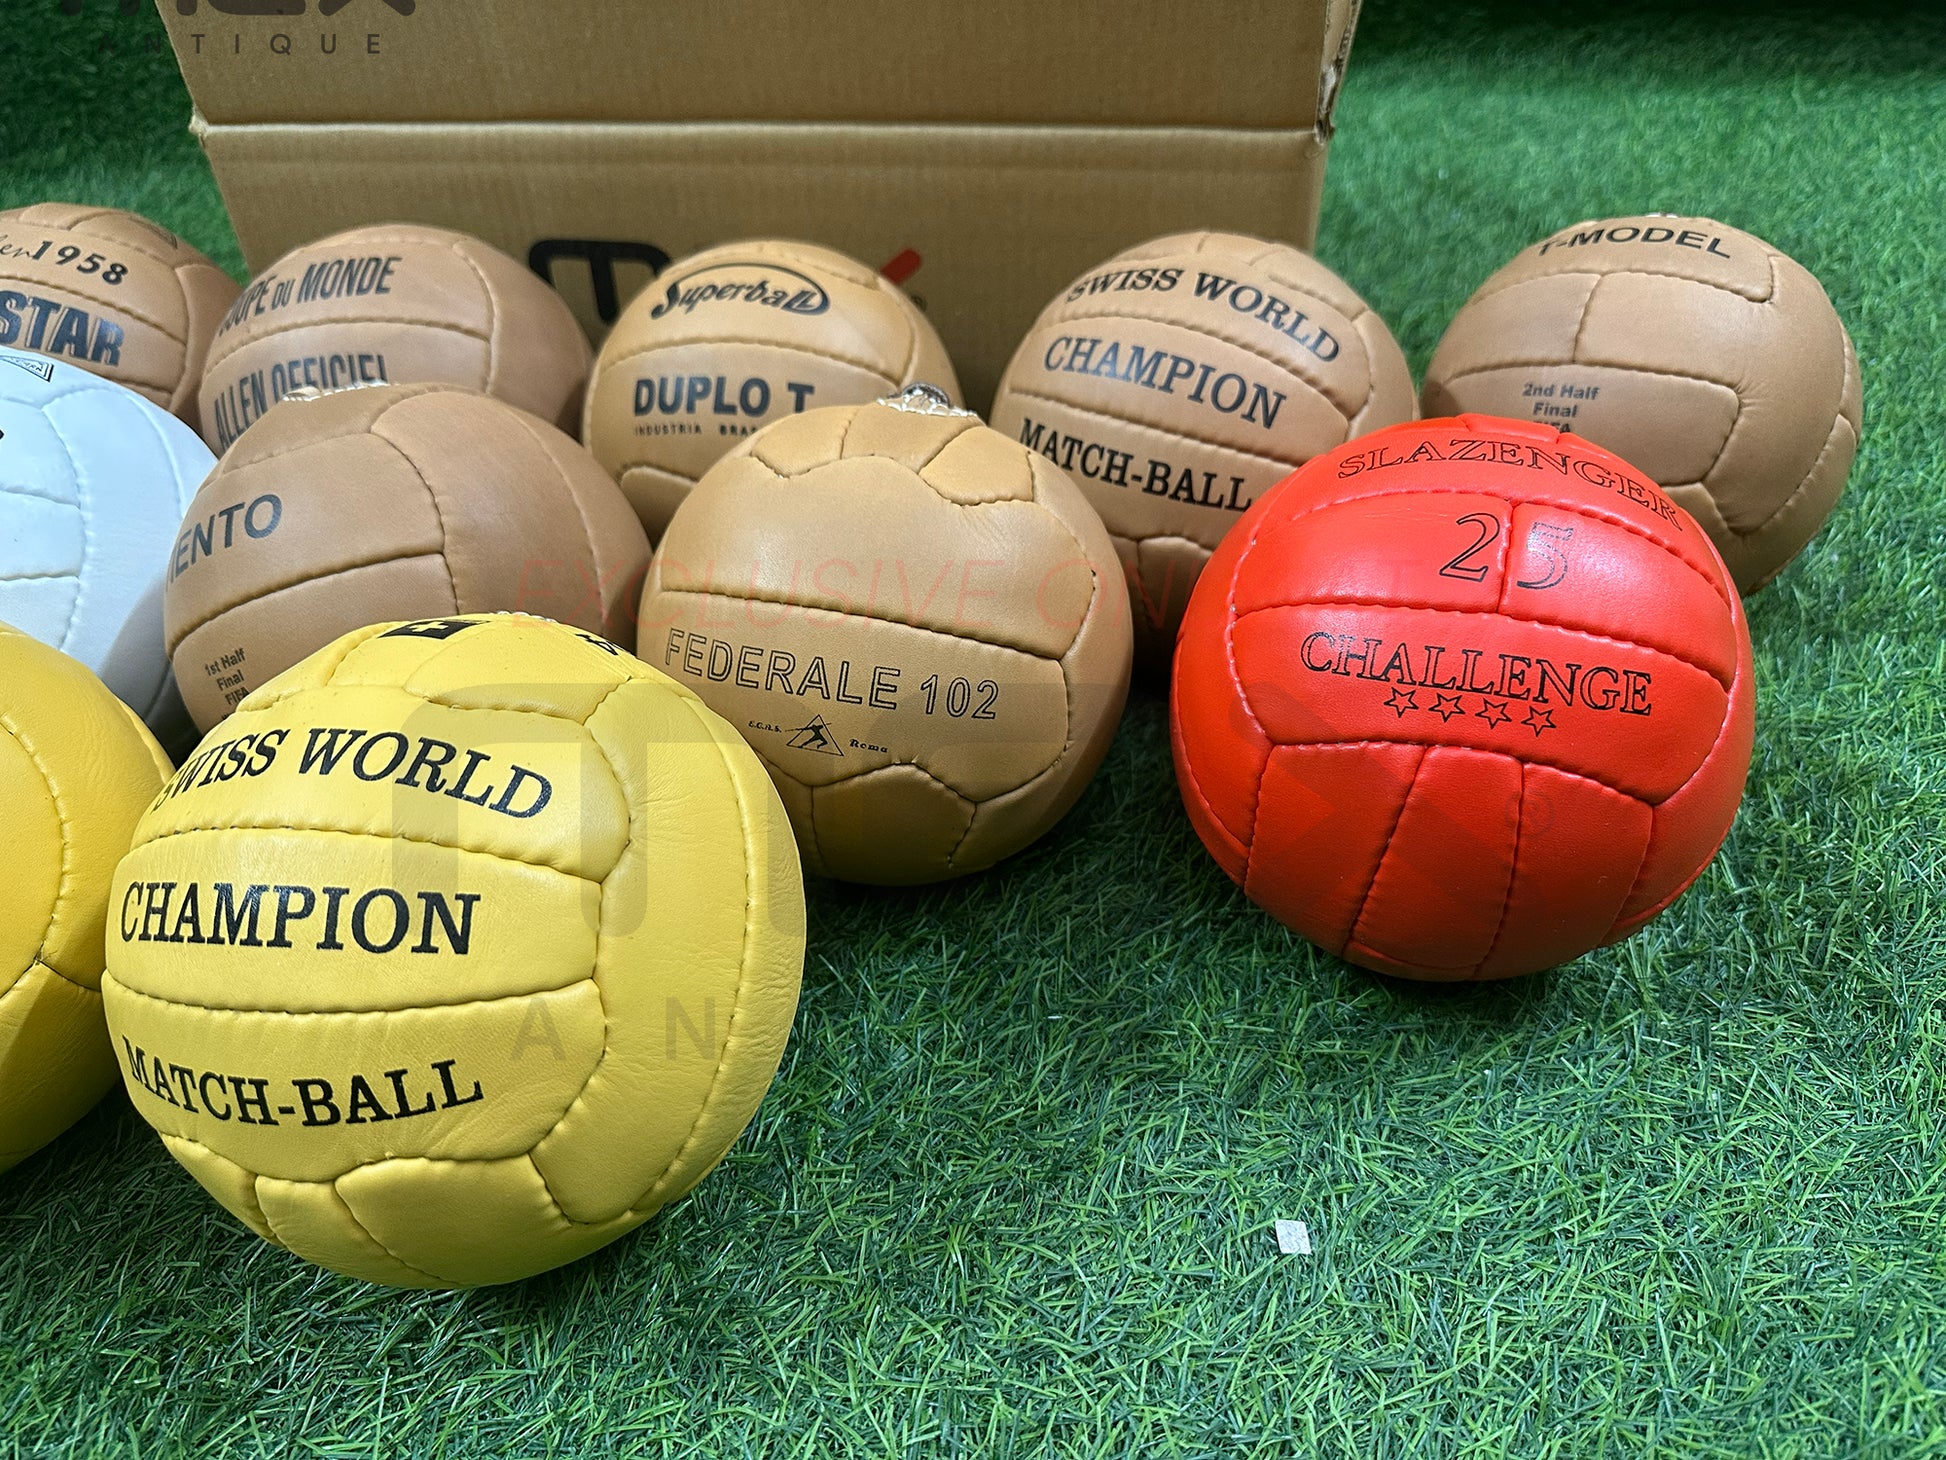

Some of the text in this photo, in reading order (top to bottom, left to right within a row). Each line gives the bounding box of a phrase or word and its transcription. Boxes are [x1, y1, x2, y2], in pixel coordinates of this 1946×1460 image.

[32, 240, 129, 285] 1958
[1538, 226, 1731, 259] T-MODEL
[271, 278, 297, 310] DU
[297, 257, 403, 303] MONDE
[651, 279, 831, 320] Superball
[1066, 267, 1340, 363] SWISS WORLD
[0, 289, 125, 367] STAR
[213, 369, 268, 451] ALLEN
[634, 375, 815, 418] DUPLO T
[1043, 335, 1287, 430] CHAMPION
[1522, 382, 1600, 401] 2nd Half
[1532, 402, 1578, 418] Final
[634, 423, 702, 437] INDUSTRIA
[1019, 417, 1252, 512] MATCH-BALL
[1338, 439, 1683, 531] SLAZENGER
[165, 494, 283, 594] IENTO
[205, 647, 246, 677] 1st Half
[216, 669, 245, 691] Final
[665, 627, 1000, 719] FEDERALE 102
[1300, 631, 1653, 716] CHALLENGE
[225, 686, 250, 706] FIFA
[149, 728, 553, 819] SWISS WORLD
[849, 738, 888, 754] Roma
[121, 881, 482, 956] CHAMPION
[122, 1034, 485, 1128] MATCH-BALL
